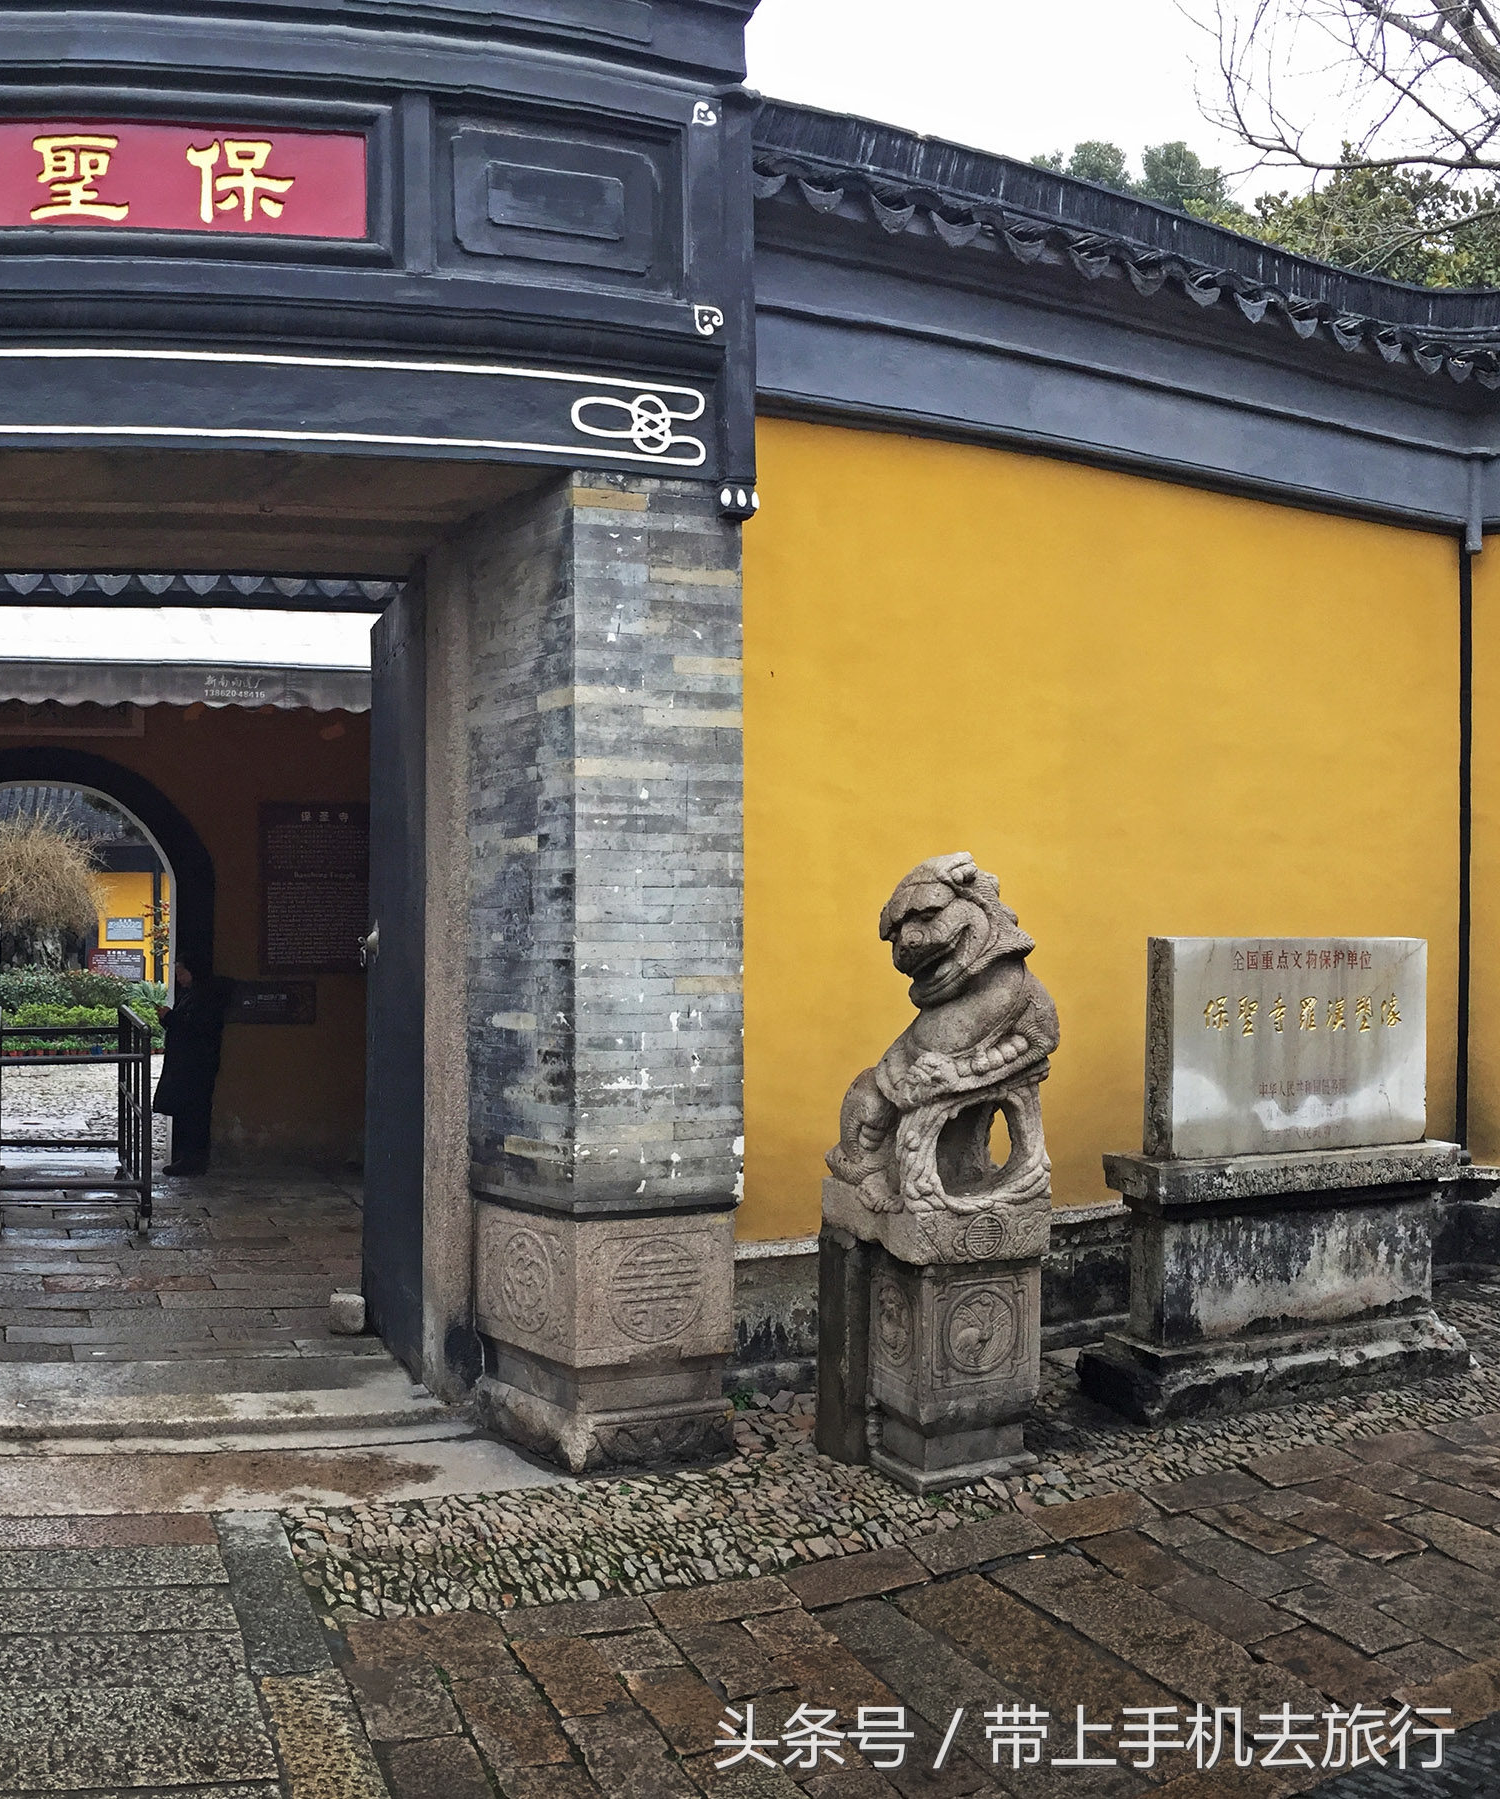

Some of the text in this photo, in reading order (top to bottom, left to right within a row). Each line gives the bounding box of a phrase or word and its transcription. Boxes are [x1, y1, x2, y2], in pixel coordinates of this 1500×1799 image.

[1232, 949, 1372, 971] 全国重点文物保护单位
